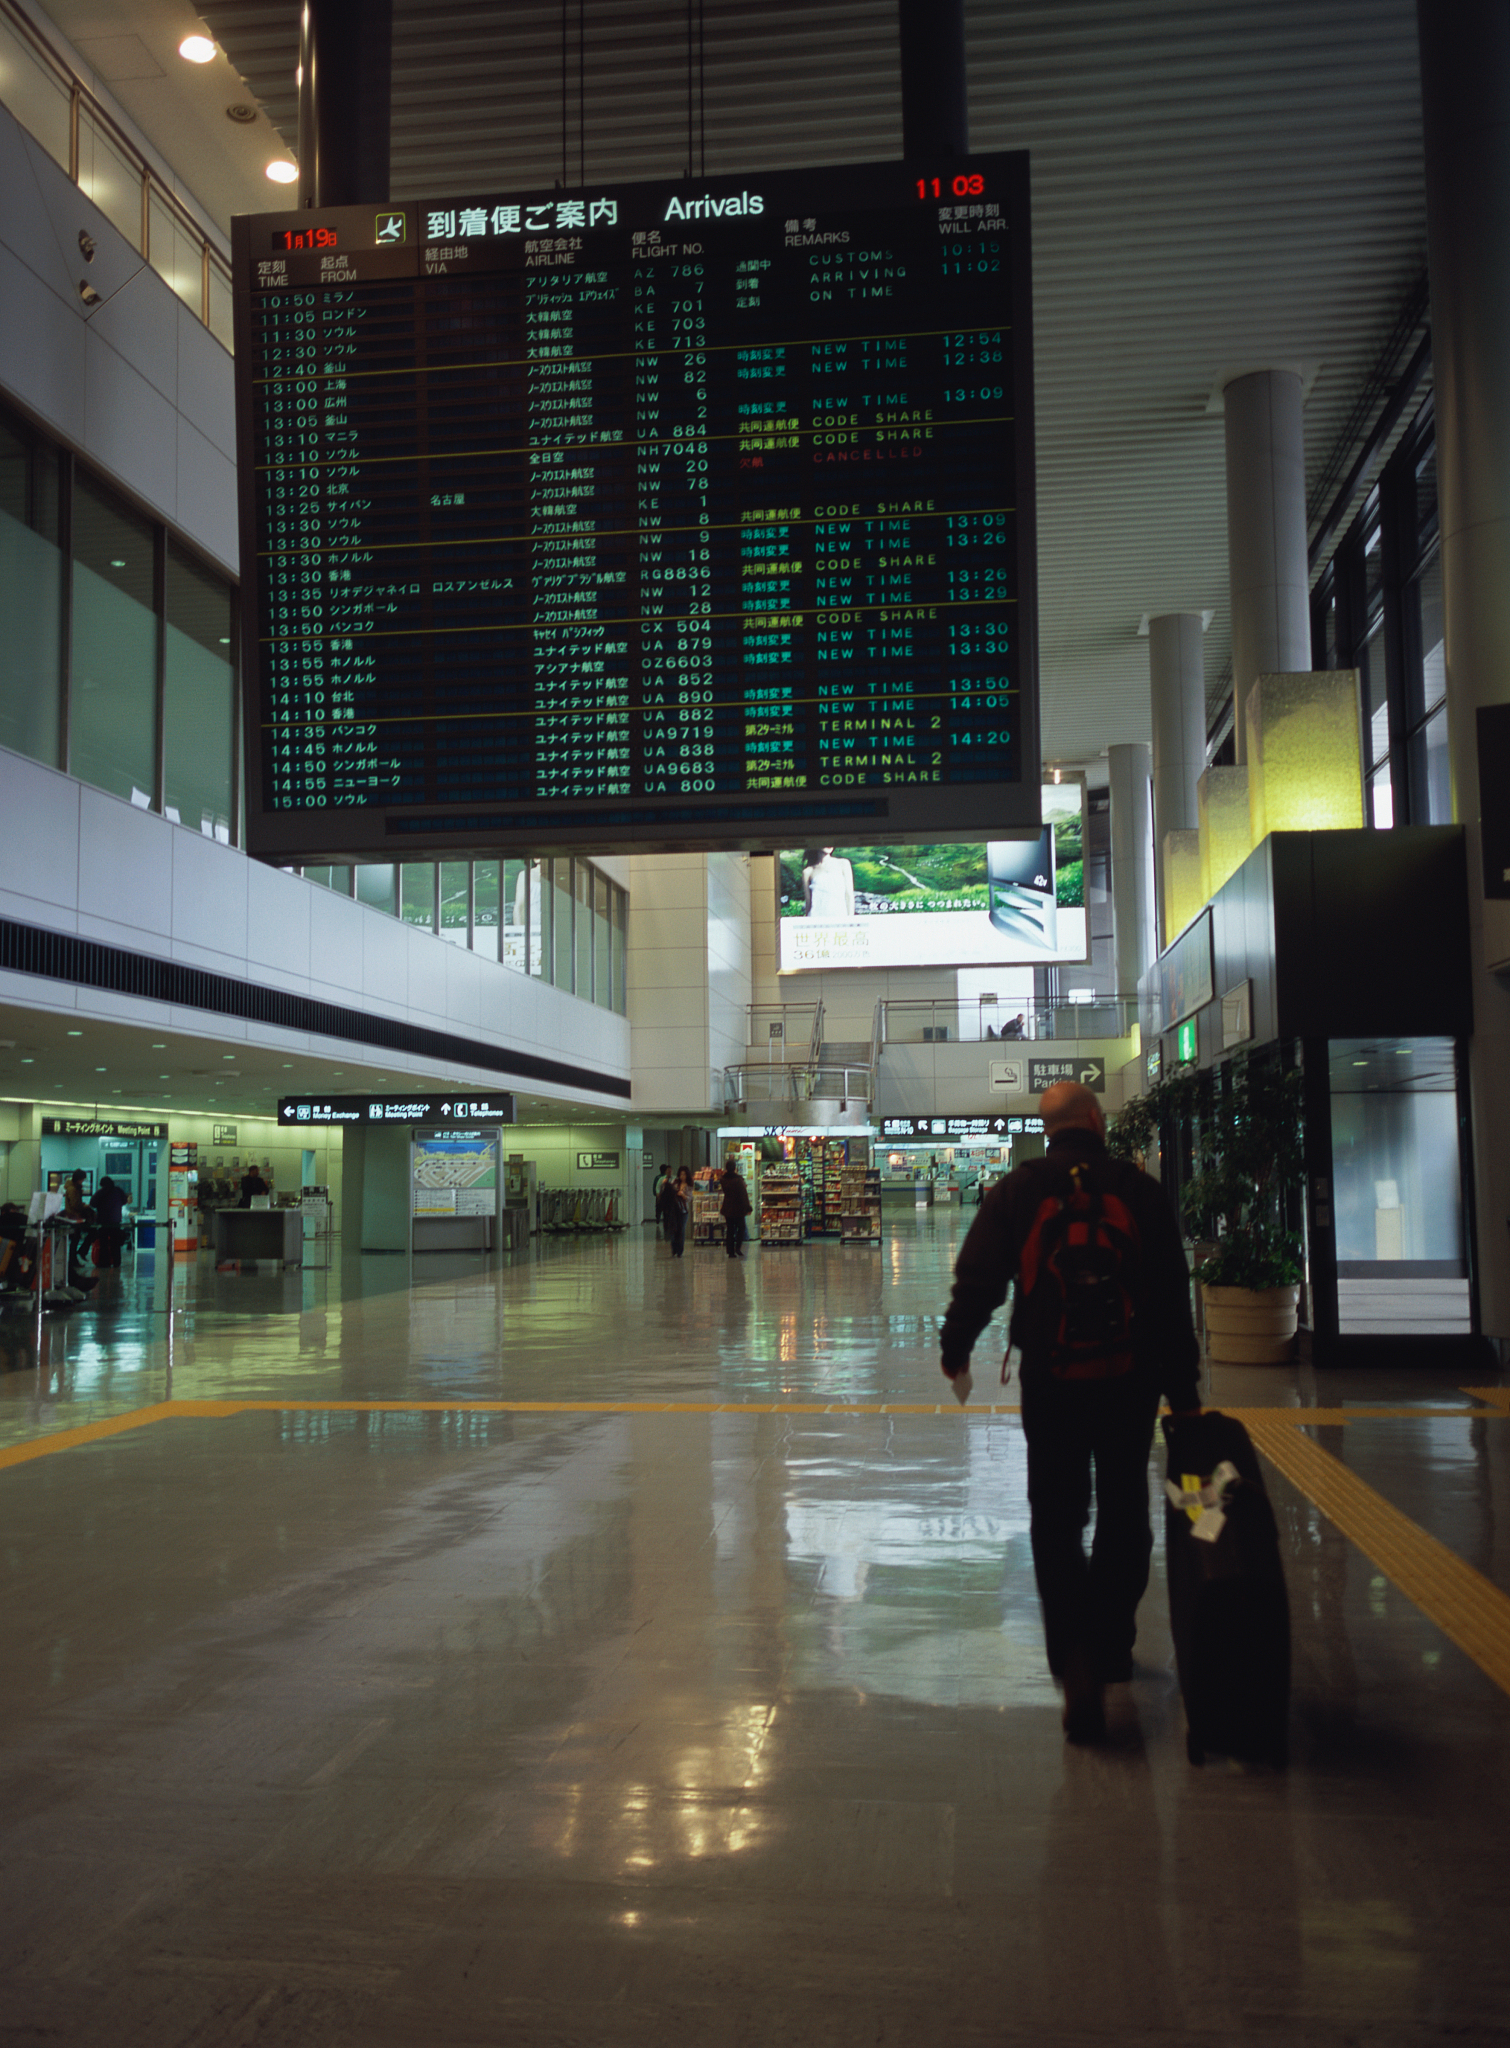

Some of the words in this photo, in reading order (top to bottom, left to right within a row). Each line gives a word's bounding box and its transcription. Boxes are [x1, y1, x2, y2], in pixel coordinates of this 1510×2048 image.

[916, 178, 941, 199] 11
[953, 174, 985, 196] 03
[427, 197, 618, 240] 到着便ご案内
[664, 191, 765, 221] Arrivals
[938, 203, 1001, 221] 変更時刻
[938, 220, 973, 234] WILL
[977, 217, 1010, 231] ARR.
[257, 260, 286, 275] 定刻
[320, 255, 348, 271] 起点
[425, 246, 469, 262] 経由地
[525, 237, 583, 253] 航空会社
[631, 230, 662, 246] 便名
[784, 218, 817, 233] 備考
[258, 273, 289, 288] TIME
[320, 269, 357, 284] FROM
[425, 263, 448, 275] VIA
[525, 252, 575, 267] AIRLINE
[632, 244, 679, 260] FLIGHT
[682, 242, 706, 256] NO.
[784, 231, 850, 248] REMARKS
[283, 228, 337, 250] 1月19日
[262, 294, 315, 308] 10:50
[323, 291, 354, 302] ミラノ
[526, 271, 608, 287] アリタリア航空
[633, 268, 655, 278] AZ
[672, 264, 705, 277] 786
[808, 250, 893, 265] CUSTOMS
[942, 242, 1000, 256] 10:15
[262, 311, 315, 325] 11:05
[321, 308, 367, 320] ロンドン
[809, 268, 906, 283] ARRIVING
[941, 260, 998, 274] 11:02
[263, 328, 316, 342] 11:30
[322, 326, 357, 337] ソウル
[525, 309, 573, 323] 大韓航空
[809, 290, 832, 301] ON
[848, 286, 892, 298] TIME
[263, 346, 317, 360] 12:30
[323, 344, 357, 355] ソウル
[264, 381, 318, 394] 13:00
[323, 379, 347, 390] 上海
[635, 357, 658, 366] NW
[683, 353, 707, 365] 26
[810, 344, 847, 354] NEW
[860, 339, 907, 351] TIME
[942, 332, 1001, 347] 12:54
[264, 363, 317, 377] 12:40
[265, 398, 318, 411] 13:00
[943, 351, 1003, 365] 12:38
[265, 433, 319, 446] 13:10
[324, 430, 359, 441] マニラ
[943, 387, 1003, 401] 13:09
[265, 416, 318, 429] 13:05
[266, 450, 319, 463] 13:10
[325, 448, 360, 459] ソウル
[528, 430, 623, 445] ユナイテッド航空
[636, 427, 659, 438] UA
[672, 424, 707, 437] 884
[811, 414, 858, 427] CODE
[874, 409, 933, 423] SHARE
[266, 467, 320, 481] 13:10
[325, 466, 360, 477] ソウル
[528, 451, 564, 464] 全日空
[636, 442, 708, 455] NH7048
[266, 484, 320, 498] 13:20
[325, 483, 349, 494] 北京
[812, 447, 922, 462] CANCELLED
[267, 501, 320, 515] 13:25
[326, 500, 372, 511] サイパン
[429, 494, 465, 506] 名古屋
[267, 519, 321, 532] 13:30
[327, 517, 362, 528] ソウル
[268, 553, 322, 567] 13:30
[327, 552, 373, 563] ホノルル
[946, 514, 1005, 528] 13:09
[268, 536, 322, 549] 13:30
[327, 535, 362, 546] ソウル
[268, 571, 322, 584] 13:30
[327, 569, 351, 581] 香港
[946, 532, 1006, 546] 13:26
[269, 588, 322, 601] 13:35
[432, 578, 513, 592] ロスアンゼルス
[640, 566, 711, 580] RG8836
[269, 605, 323, 618] 13:50
[329, 603, 398, 615] シンガポール
[947, 569, 1007, 582] 13:26
[270, 622, 324, 636] 13:50
[328, 620, 374, 632] バンコク
[947, 587, 1007, 600] 13:29
[270, 639, 323, 653] 13:55
[329, 638, 353, 650] 香港
[640, 622, 663, 633] CX
[676, 619, 711, 632] 504
[270, 657, 324, 670] 13:55
[330, 655, 376, 667] ホノルル
[533, 642, 628, 656] ユナイテッド航空
[948, 623, 1008, 637] 13:30
[270, 674, 324, 687] 13:55
[330, 673, 376, 684] ホノルル
[534, 660, 605, 674] アシアナ航空
[641, 655, 713, 668] OZ6603
[948, 641, 1009, 655] 13:30
[271, 691, 325, 704] 14:10
[330, 690, 355, 702] 台北
[271, 708, 326, 721] 14:10
[330, 707, 355, 719] 香港
[949, 677, 1009, 691] 13:50
[272, 726, 326, 738] 14:35
[331, 724, 377, 735] バンコク
[950, 695, 1009, 709] 14:05
[272, 743, 326, 756] 14:45
[331, 741, 378, 753] ホノルル
[643, 726, 714, 739] UA9719
[819, 718, 915, 731] TERMINAL
[930, 716, 941, 728] 2
[272, 760, 327, 773] 14:50
[332, 758, 401, 770] シンガポール
[950, 731, 1010, 745] 14:20
[273, 777, 327, 790] 14:55
[333, 775, 401, 787] ニューヨーク
[643, 761, 715, 775] UA9683
[273, 794, 327, 807] 15:00
[333, 793, 368, 805] ソウル
[644, 781, 666, 792] UA
[679, 779, 716, 792] 800
[793, 931, 869, 947] 世界最高
[1033, 1063, 1074, 1076] 駐車場
